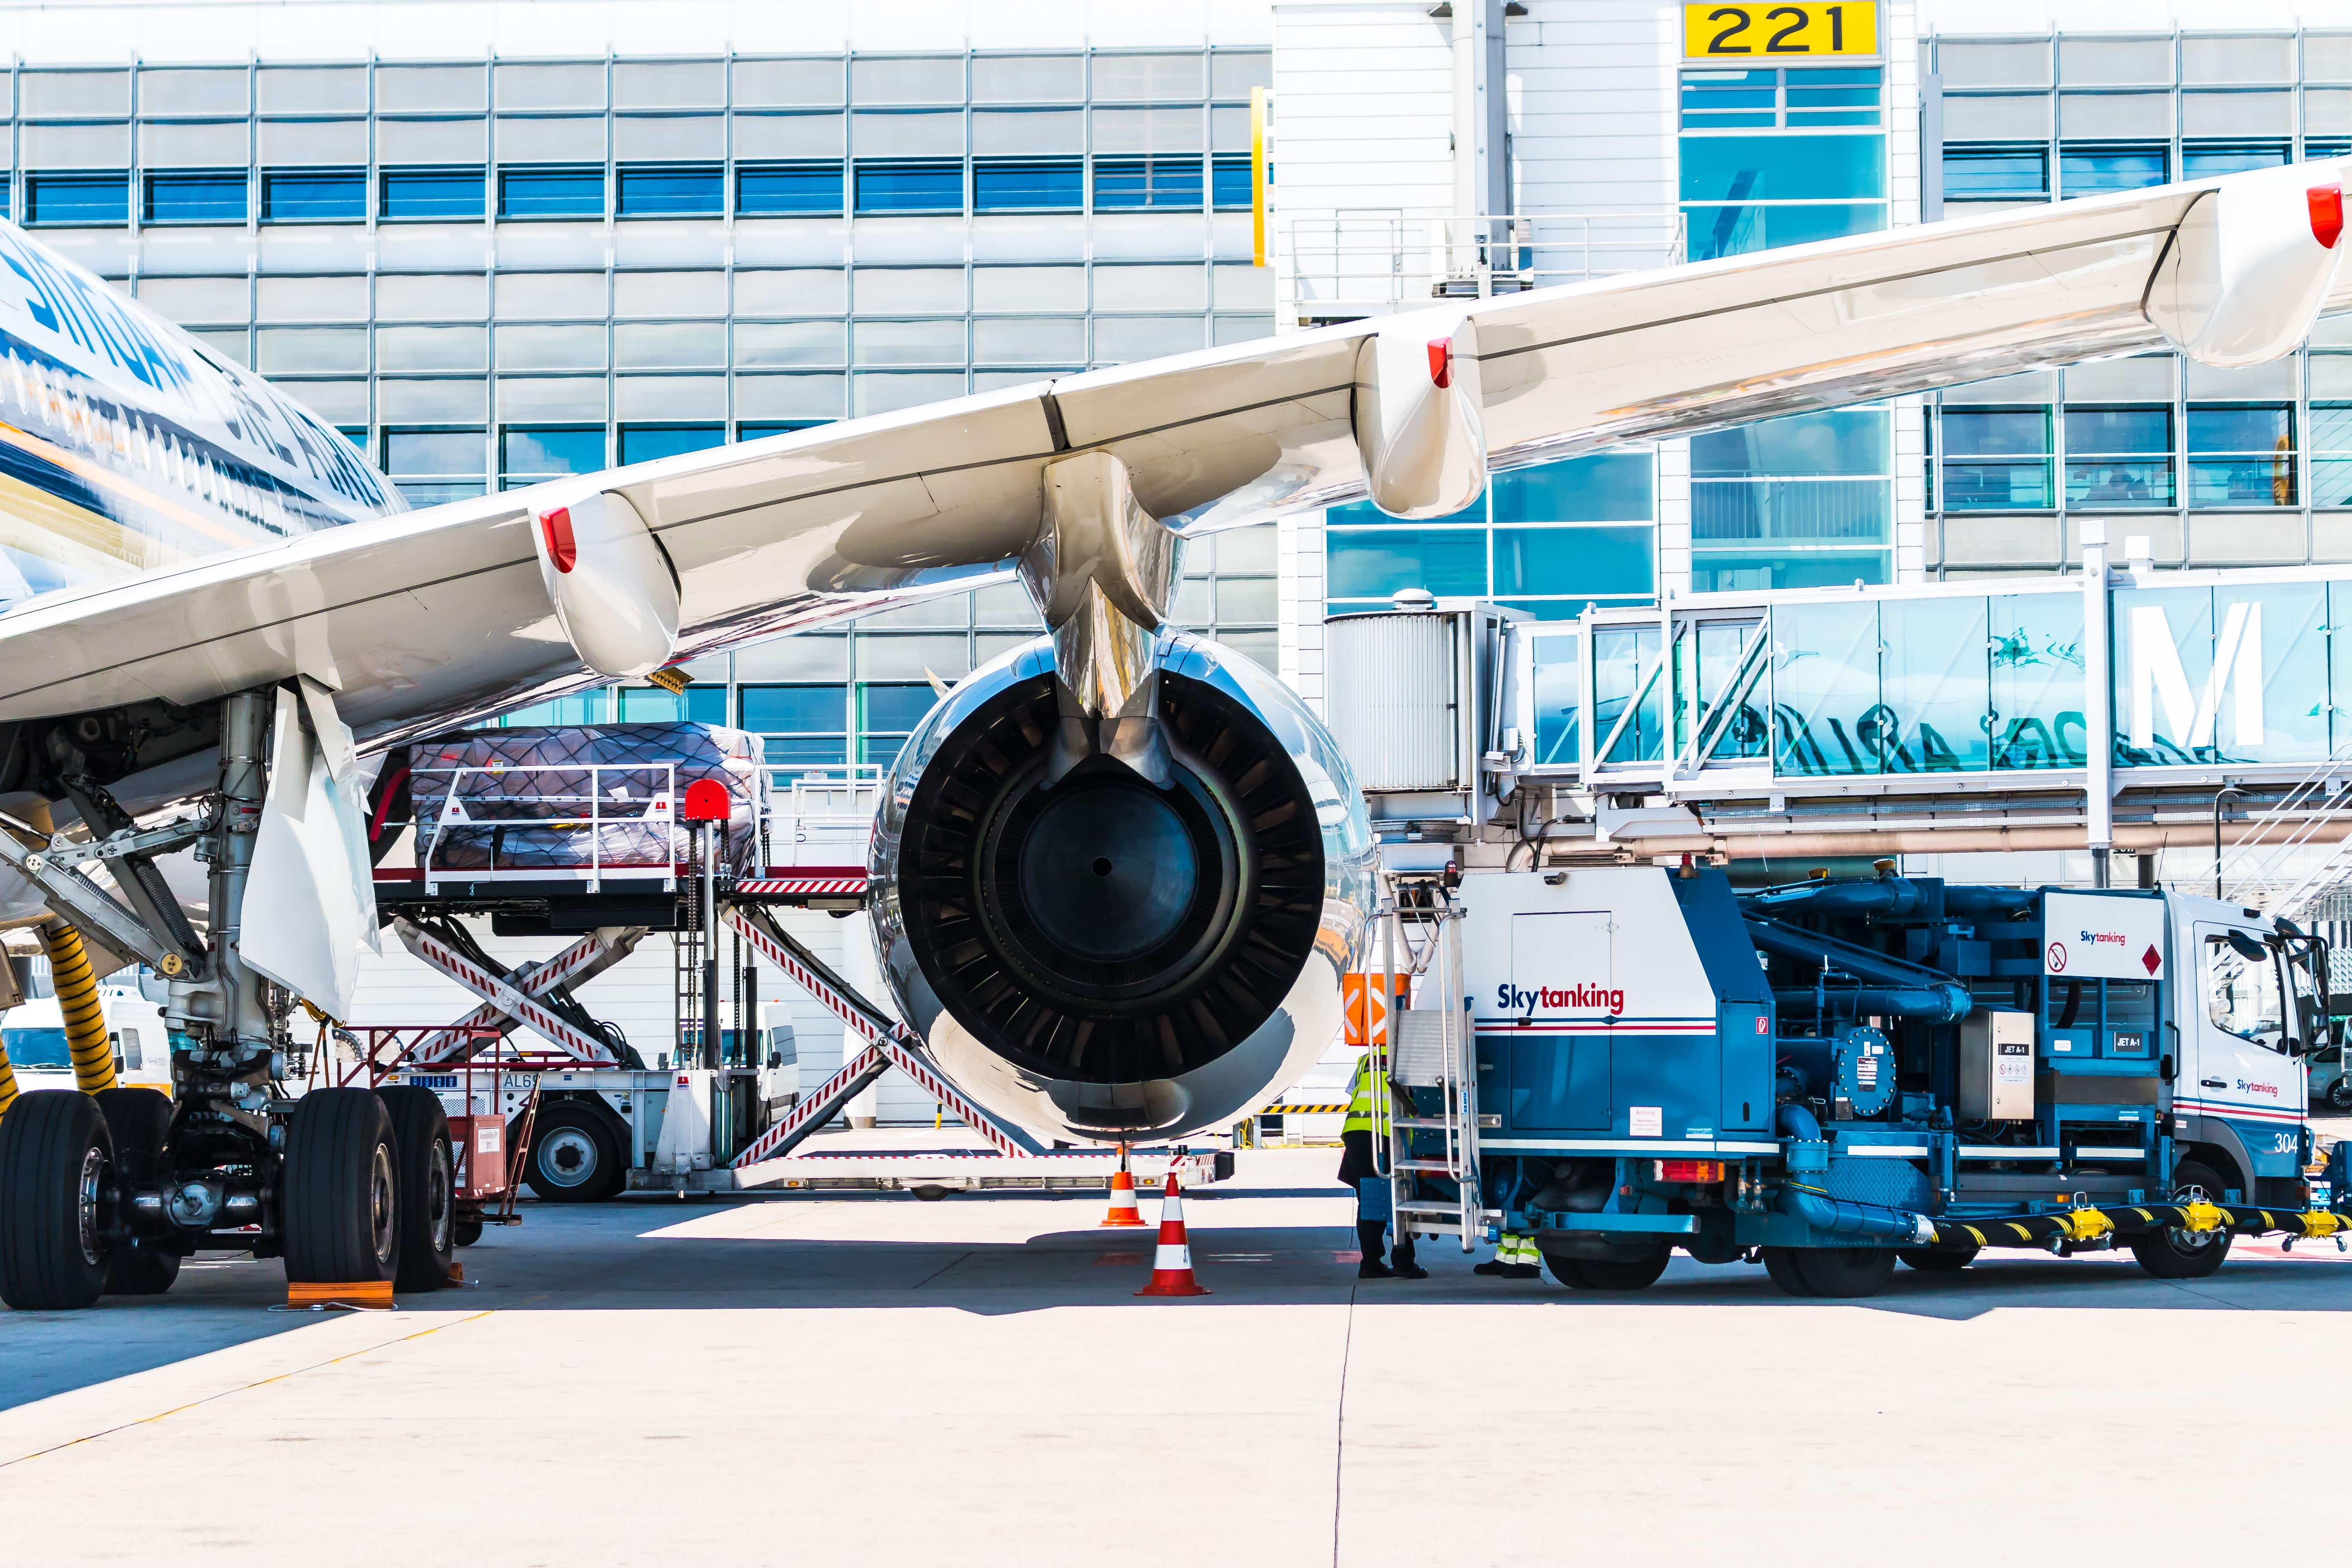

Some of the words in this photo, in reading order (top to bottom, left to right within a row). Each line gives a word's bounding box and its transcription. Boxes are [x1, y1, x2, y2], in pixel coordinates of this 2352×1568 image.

[1707, 6, 1843, 54] 221
[2132, 601, 2264, 749] M
[2081, 930, 2125, 946] Skytanking
[1498, 982, 1624, 1017] Skytanking
[2117, 1038, 2129, 1046] JET
[2237, 1079, 2278, 1097] Skytanking
[2274, 1133, 2298, 1154] 304
